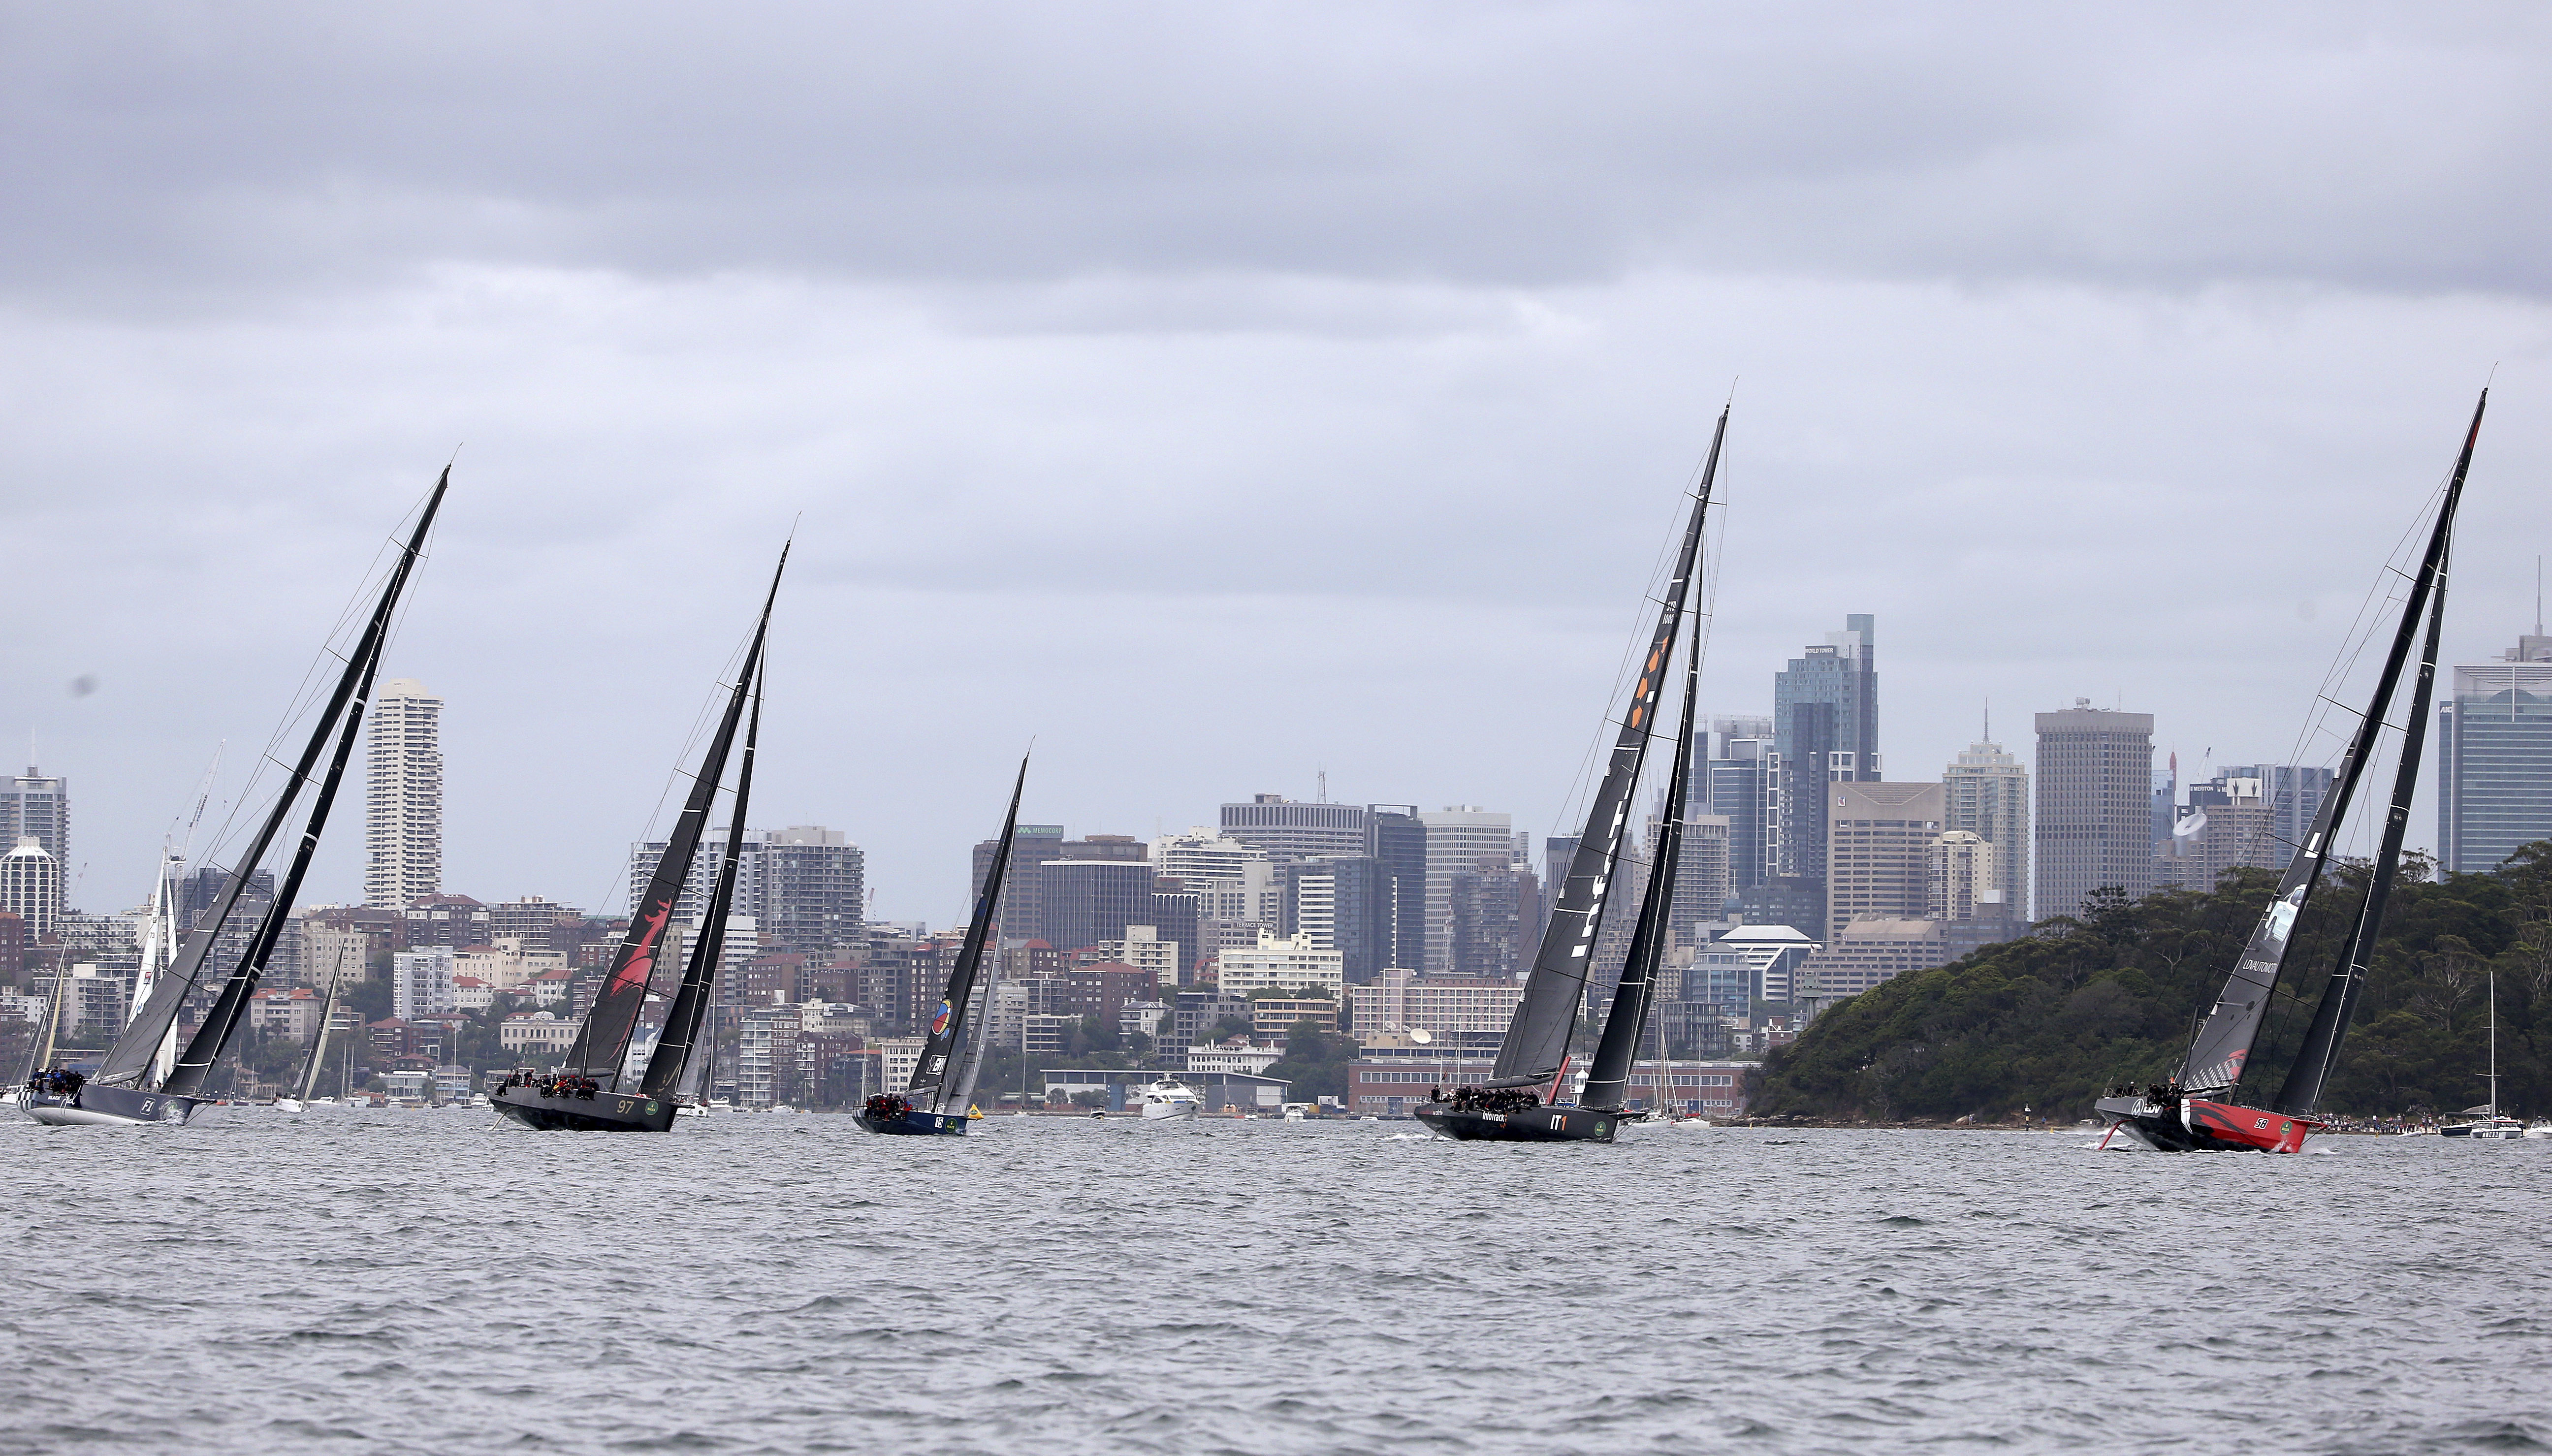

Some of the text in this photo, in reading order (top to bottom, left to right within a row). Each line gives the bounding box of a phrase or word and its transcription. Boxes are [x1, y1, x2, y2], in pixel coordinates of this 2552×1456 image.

[141, 1100, 154, 1112] F1
[617, 1100, 635, 1114] 97
[2143, 1103, 2162, 1114] LDV
[937, 1118, 943, 1127] 15
[1550, 1114, 1568, 1131] IT1
[2255, 1118, 2268, 1129] 58
